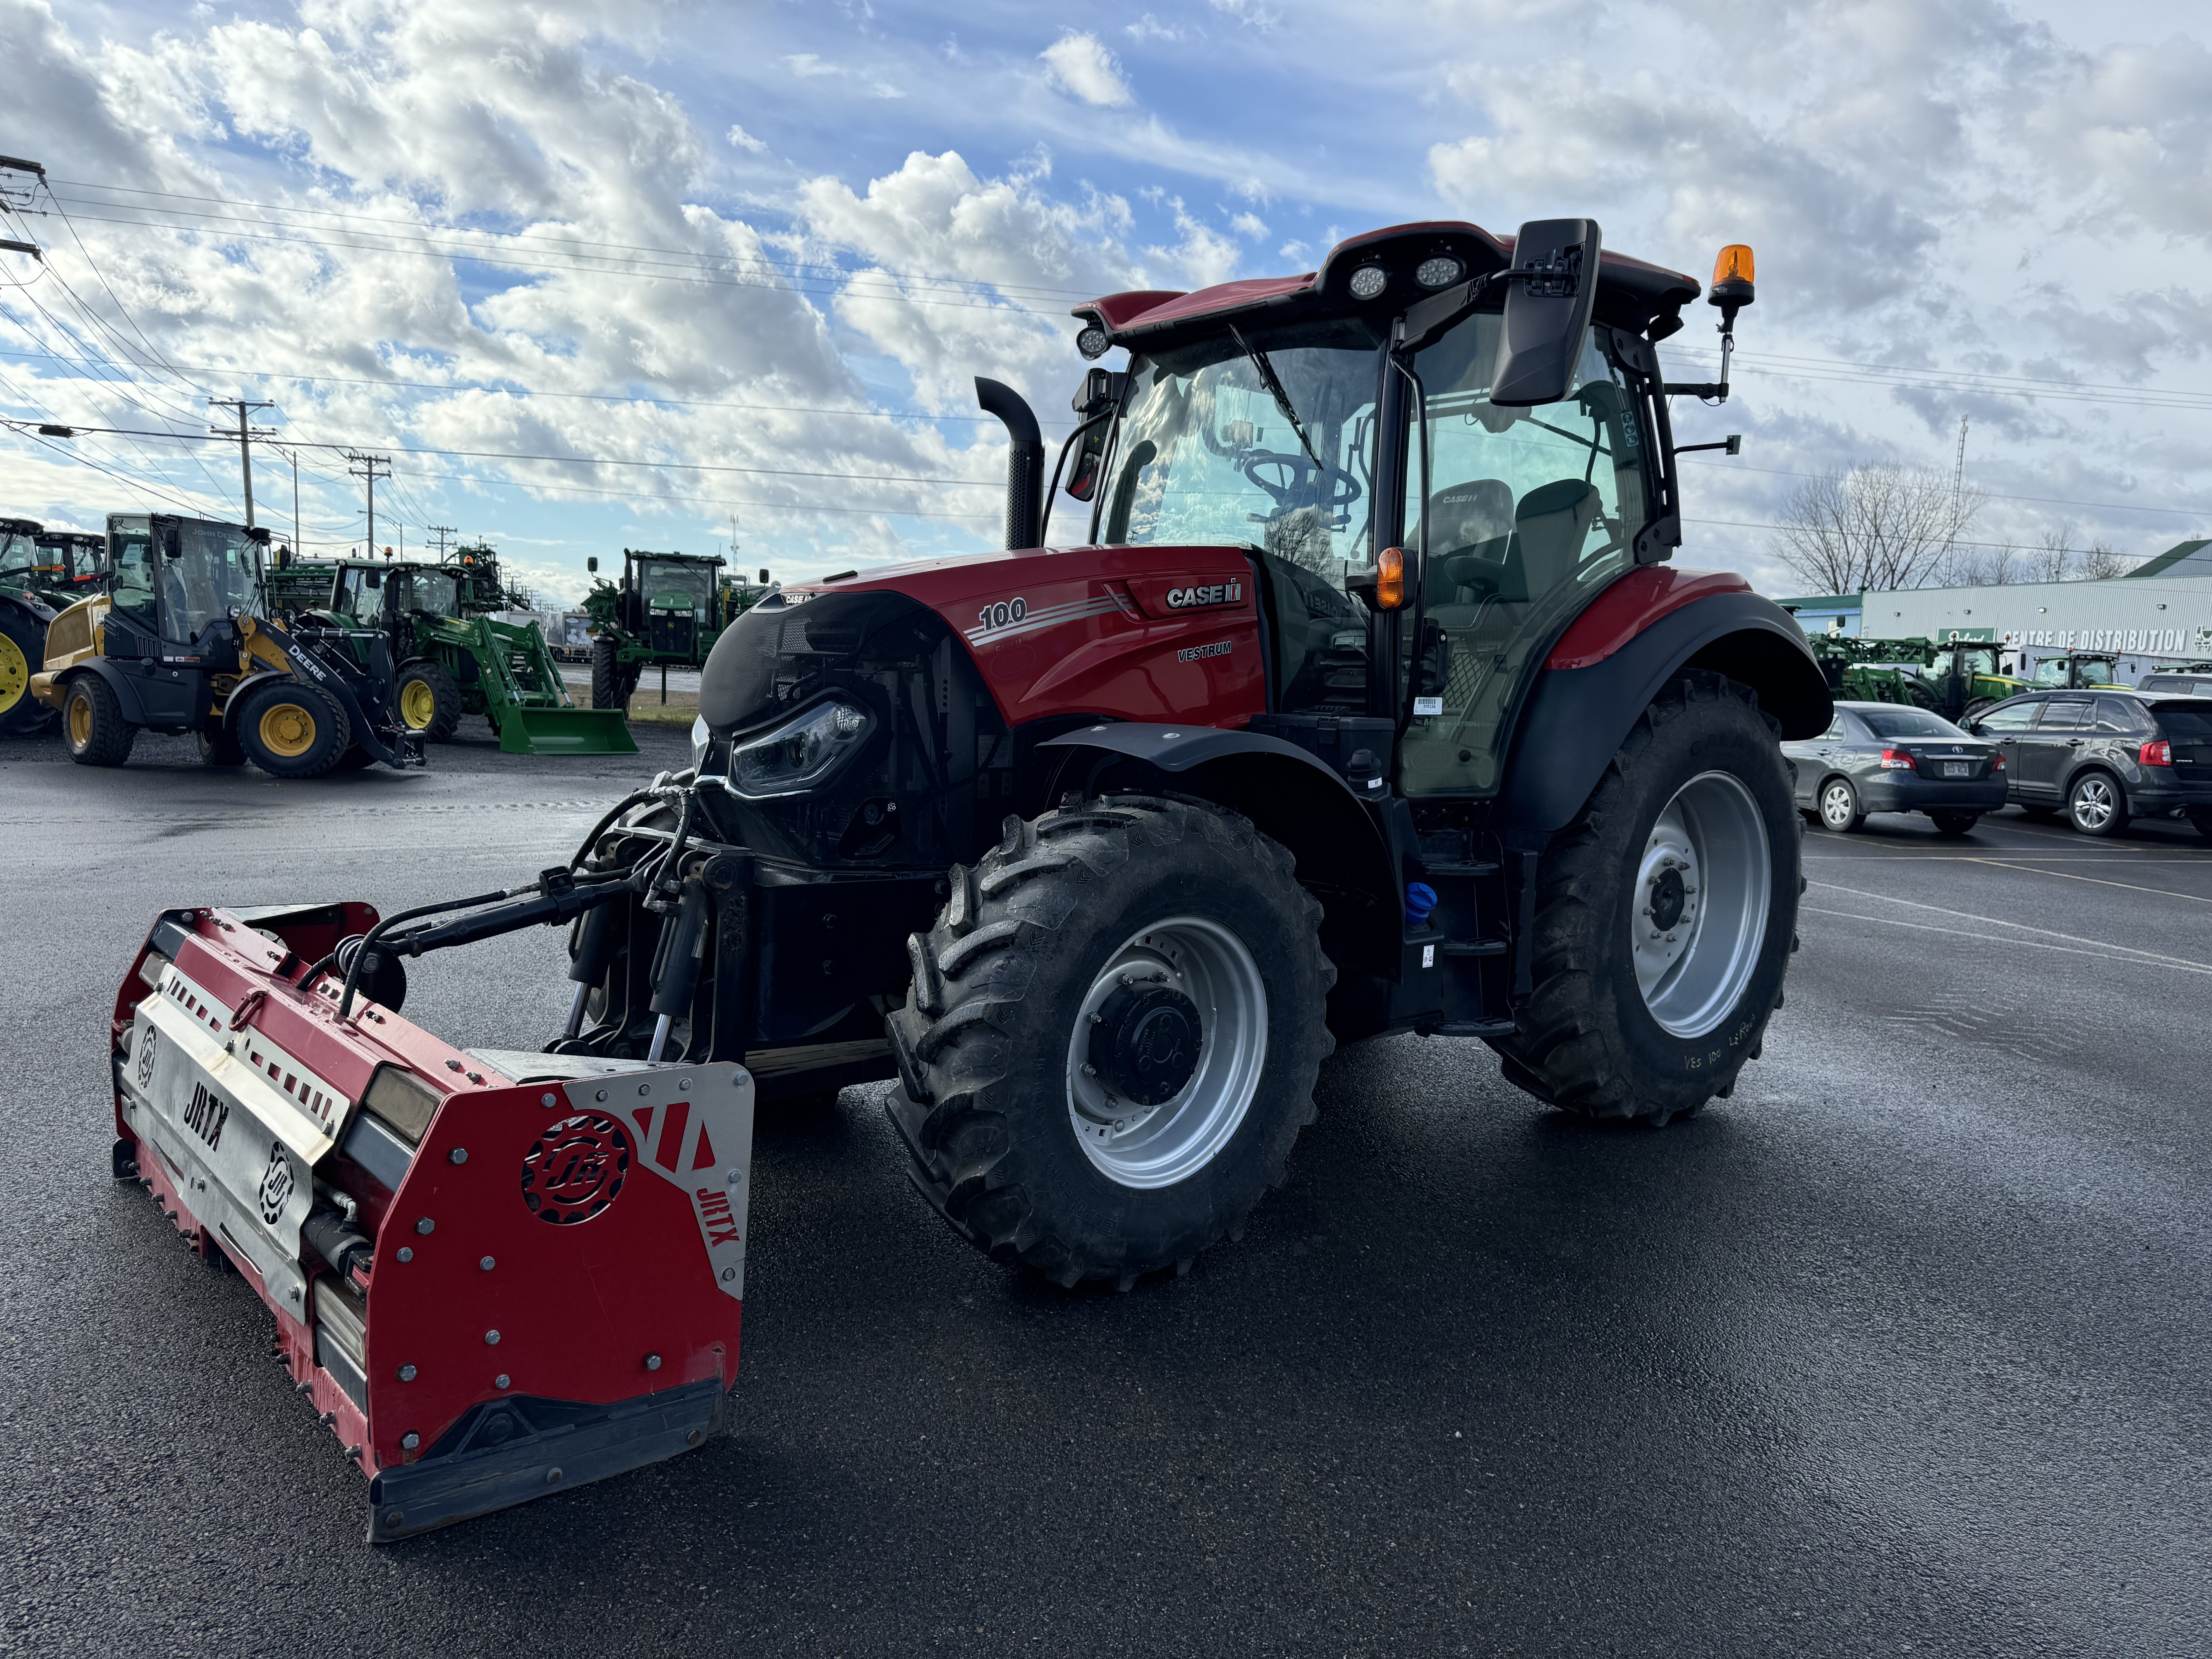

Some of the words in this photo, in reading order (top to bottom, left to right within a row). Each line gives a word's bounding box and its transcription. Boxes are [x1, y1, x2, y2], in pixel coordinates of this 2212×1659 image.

[1443, 495, 1469, 503] CASE
[786, 596, 804, 604] CASE
[1168, 585, 1222, 608] CASE
[979, 597, 1027, 632] 100
[1178, 641, 1231, 662] VESTRUM
[2059, 630, 2076, 648] DE
[2081, 629, 2186, 651] DISTRIBUTION
[289, 644, 326, 681] DEERE
[1709, 1048, 1721, 1064] 100
[184, 1080, 229, 1152] JRTX
[268, 1171, 287, 1196] JR
[696, 1188, 740, 1247] JRTX
